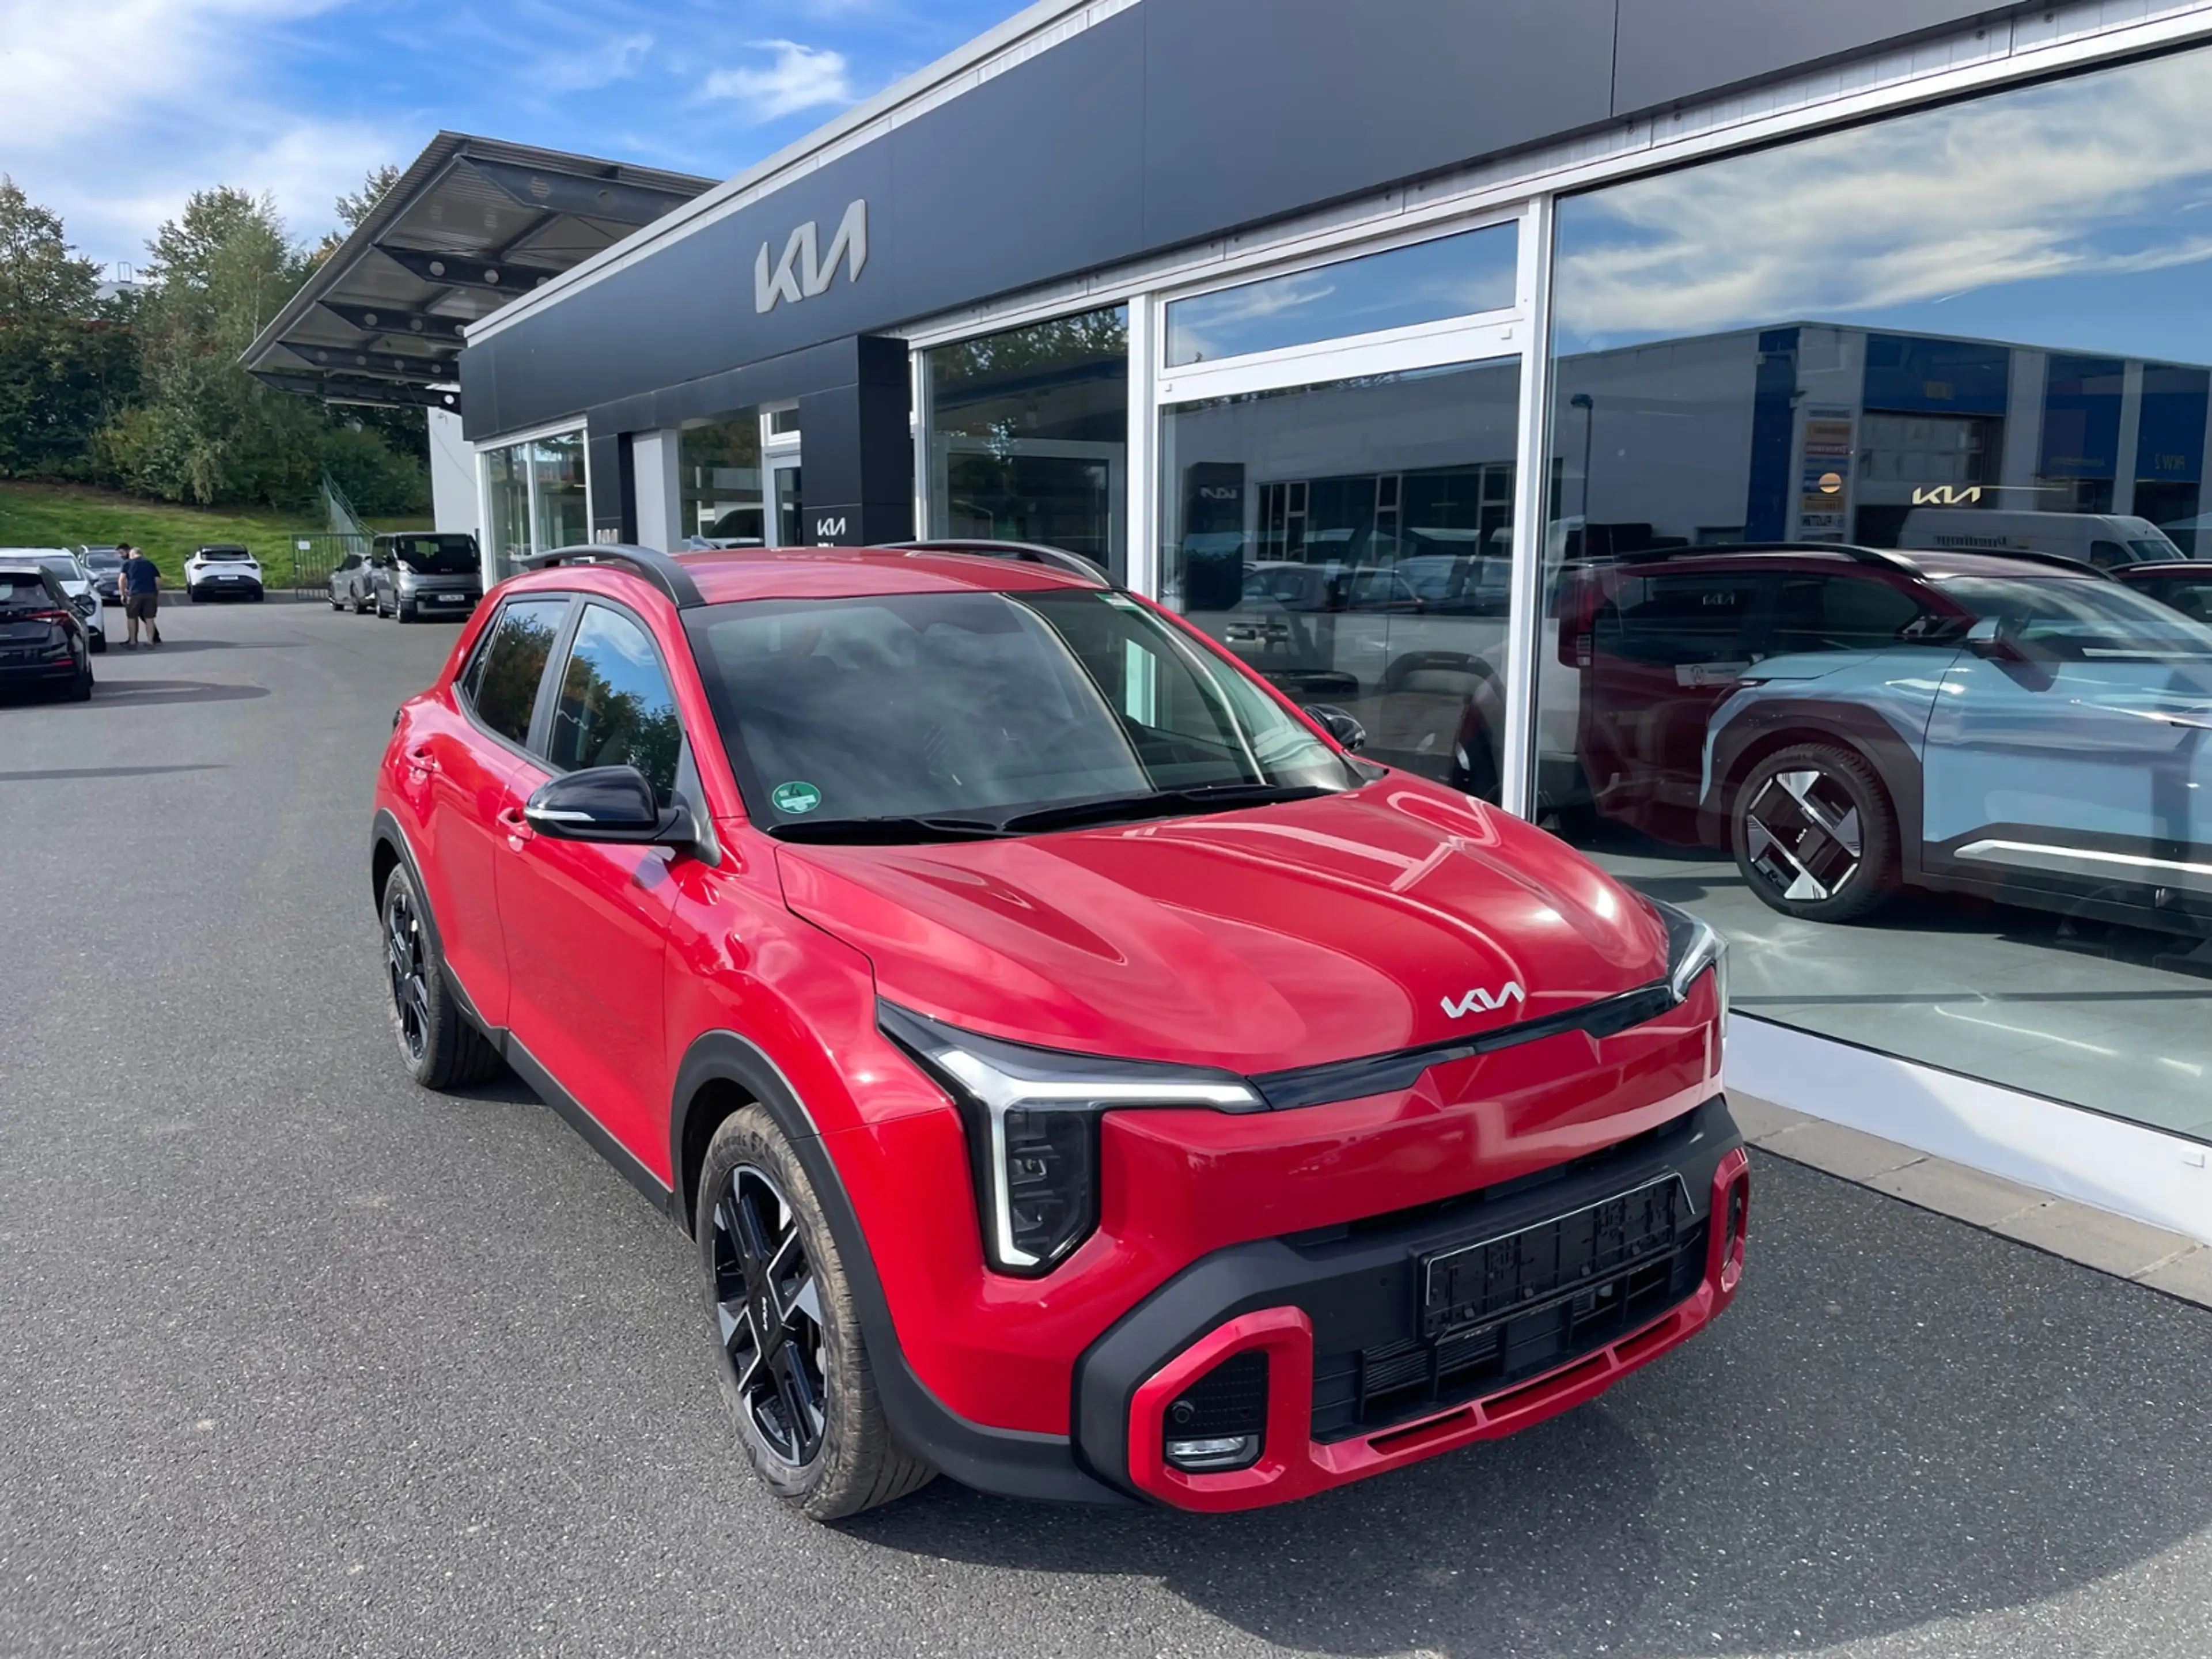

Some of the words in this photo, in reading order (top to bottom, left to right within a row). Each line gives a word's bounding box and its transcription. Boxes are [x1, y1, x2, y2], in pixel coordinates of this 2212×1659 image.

[755, 199, 867, 313] KIA
[1911, 485, 1980, 505] KIA
[817, 517, 846, 536] KIA
[788, 782, 801, 797] 4
[1440, 981, 1525, 1019] KIA
